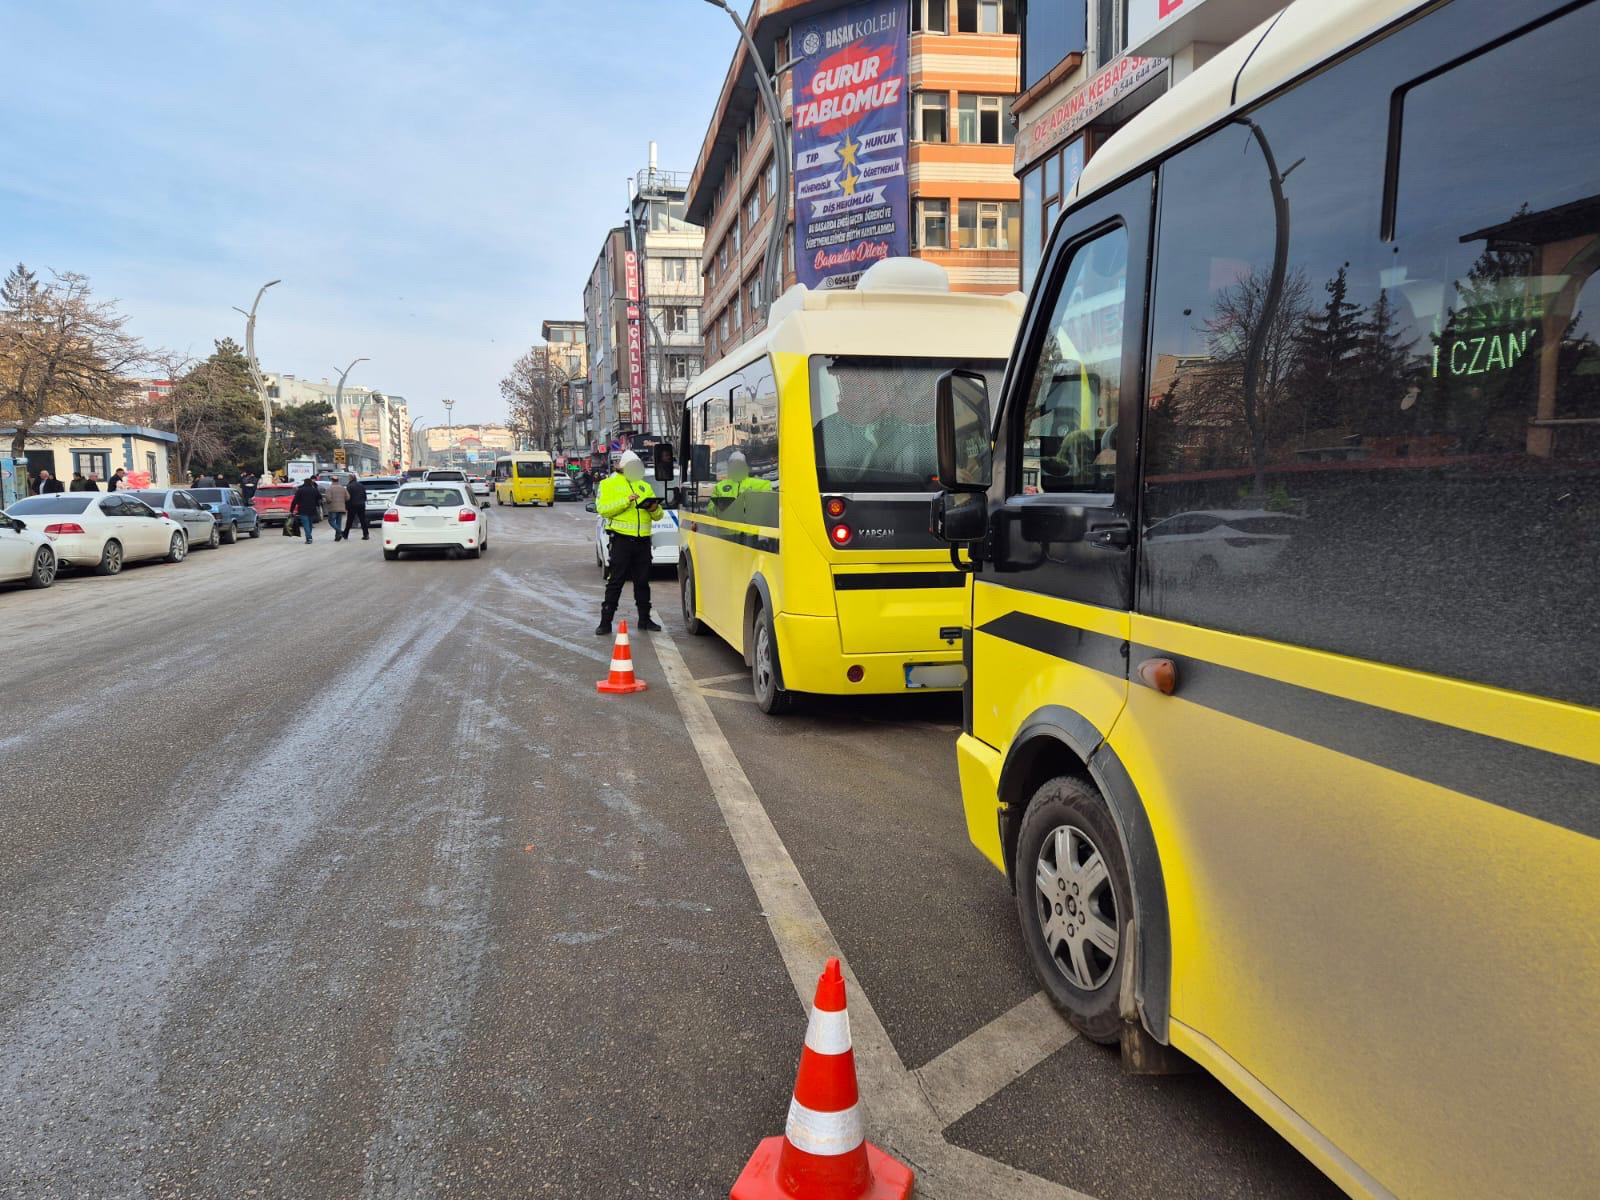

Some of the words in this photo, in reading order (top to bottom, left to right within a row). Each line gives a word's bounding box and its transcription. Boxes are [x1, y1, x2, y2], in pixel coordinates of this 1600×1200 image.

[826, 24, 854, 48] BAŞAK
[855, 8, 896, 38] KOLEJİ
[812, 56, 880, 95] GURUR
[1050, 94, 1085, 129] ADANA
[1088, 60, 1128, 99] KEBAP
[796, 78, 902, 128] TABLOMUZ
[865, 132, 897, 149] HUKUK
[822, 203, 835, 214] DİŞ
[627, 253, 637, 300] OTEL
[858, 529, 895, 537] KARSAN
